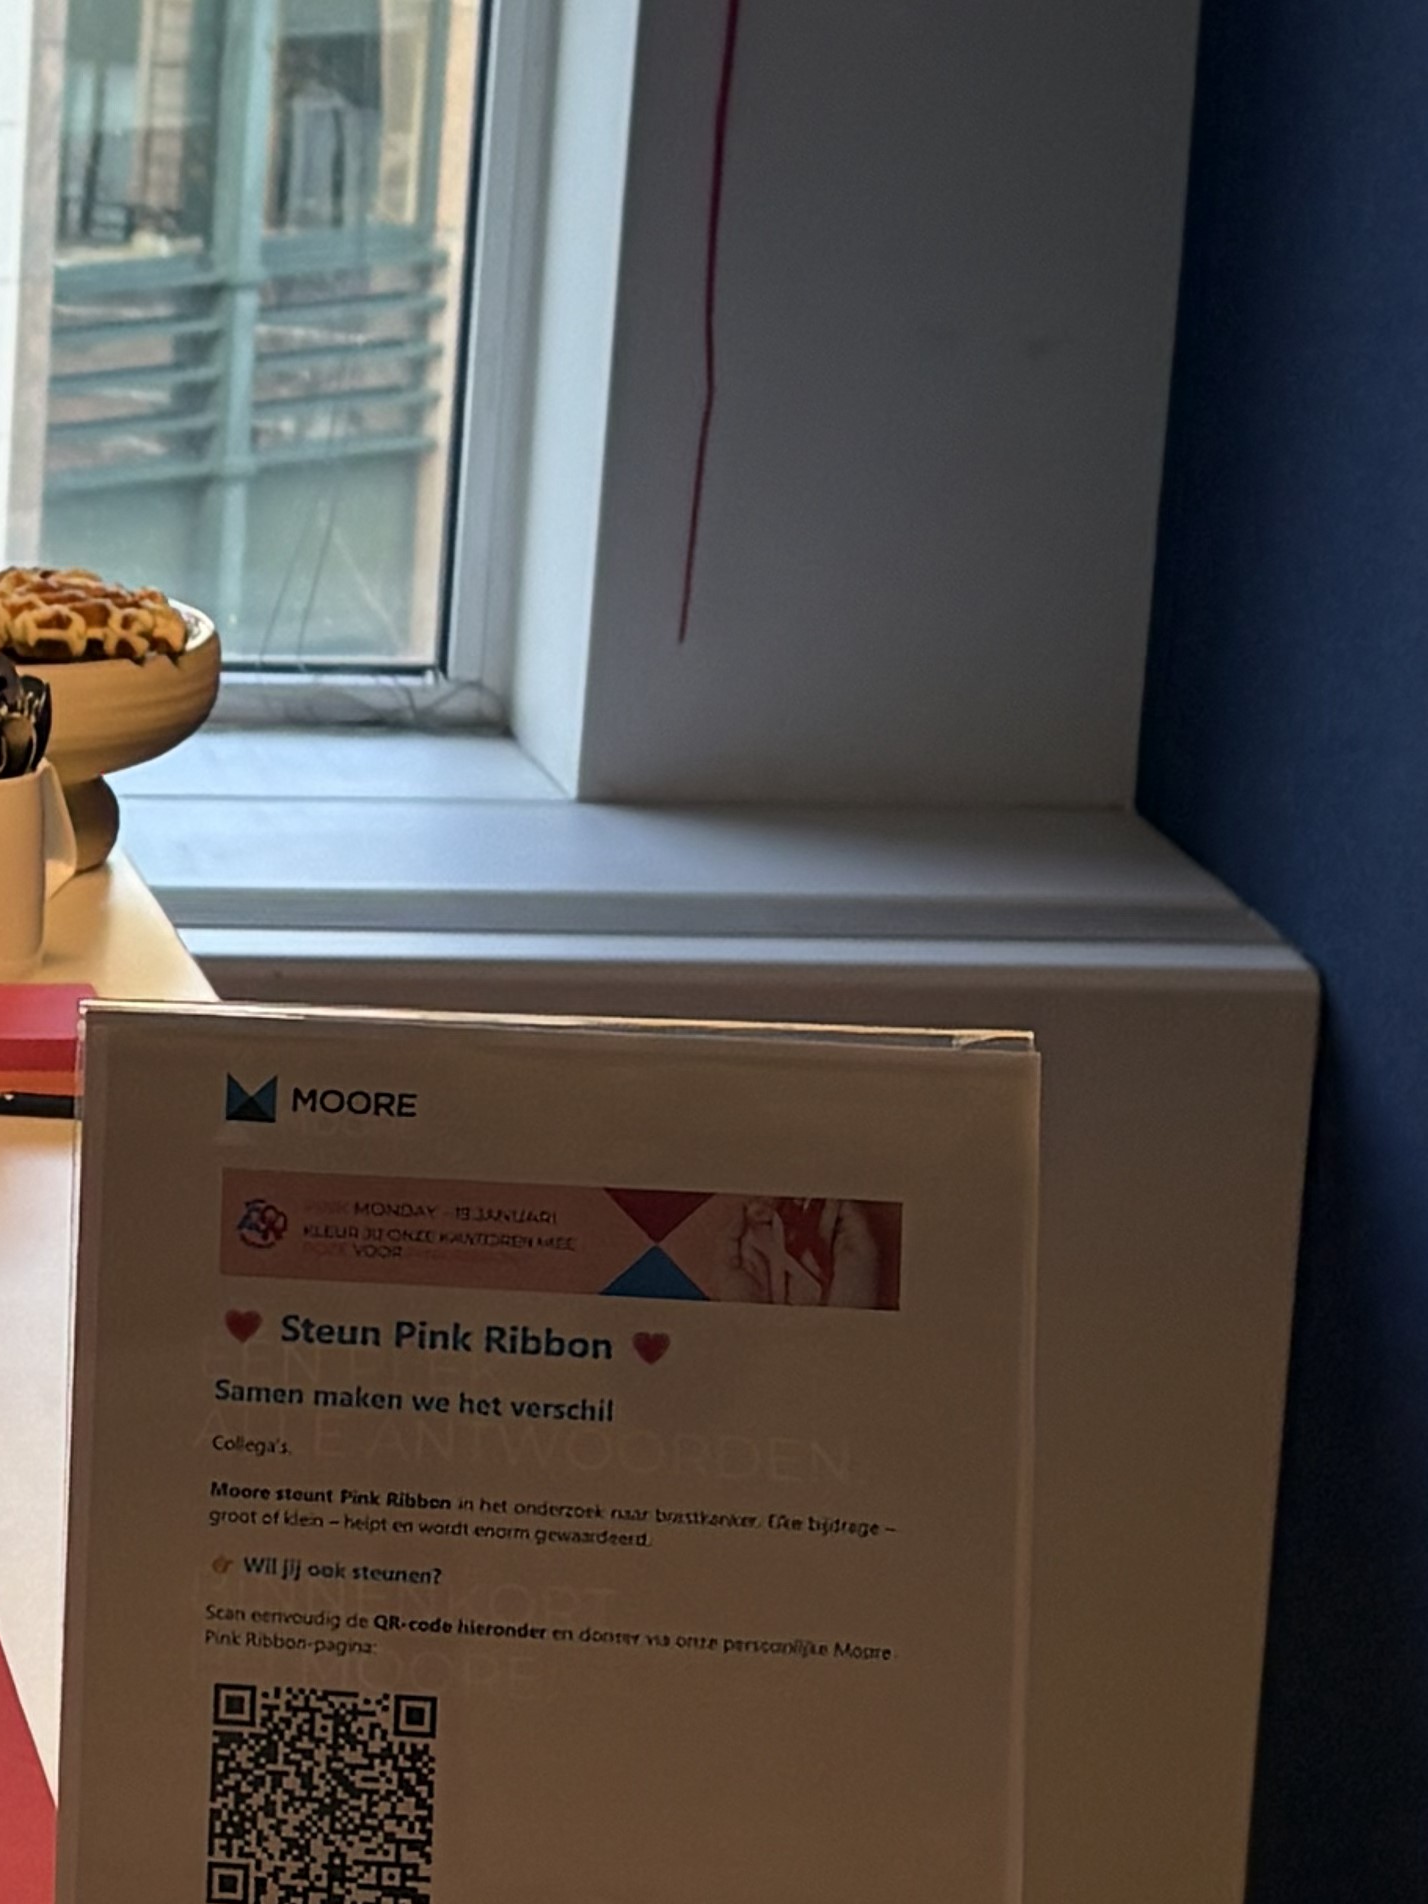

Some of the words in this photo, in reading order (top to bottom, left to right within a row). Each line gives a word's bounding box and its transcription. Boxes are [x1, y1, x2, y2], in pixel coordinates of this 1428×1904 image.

[291, 1087, 419, 1118] MOORE
[354, 1201, 438, 1218] MONDAY
[281, 1314, 382, 1348] Steun
[394, 1320, 472, 1353] Pink
[484, 1325, 613, 1360] Ribbon
[214, 1379, 304, 1405] Samen
[313, 1385, 403, 1412] maken
[412, 1395, 450, 1414] we
[459, 1391, 502, 1417] het
[510, 1397, 614, 1422] verschil
[208, 1509, 257, 1527] groot
[263, 1509, 280, 1526] of
[283, 1511, 325, 1528] klein
[344, 1514, 388, 1534] helpt
[392, 1519, 414, 1534] en
[418, 1519, 470, 1537] wordt
[474, 1524, 530, 1541] enorm
[209, 1481, 271, 1501] Moore
[276, 1486, 333, 1504] steunt
[339, 1487, 381, 1507] Pink
[385, 1491, 452, 1511] Ribbon
[457, 1497, 474, 1512] in
[479, 1497, 508, 1514] het
[514, 1499, 603, 1520] onderzoek
[610, 1507, 649, 1522] naar
[806, 1516, 880, 1539] bijdrage
[243, 1556, 278, 1575] Wil
[282, 1559, 303, 1581] jij
[307, 1560, 346, 1578] ook
[351, 1564, 443, 1585] steunen?
[204, 1629, 241, 1649] Pink
[244, 1632, 378, 1657] Ribbon-pagina:
[205, 1604, 246, 1624] Scan
[250, 1607, 341, 1631] eenvoudig
[346, 1613, 370, 1630] de
[373, 1615, 453, 1636] QR-code
[457, 1619, 547, 1641] hieronder
[552, 1628, 574, 1643] en
[646, 1631, 671, 1647] via
[675, 1634, 719, 1651] onze
[833, 1642, 893, 1661] Moore
